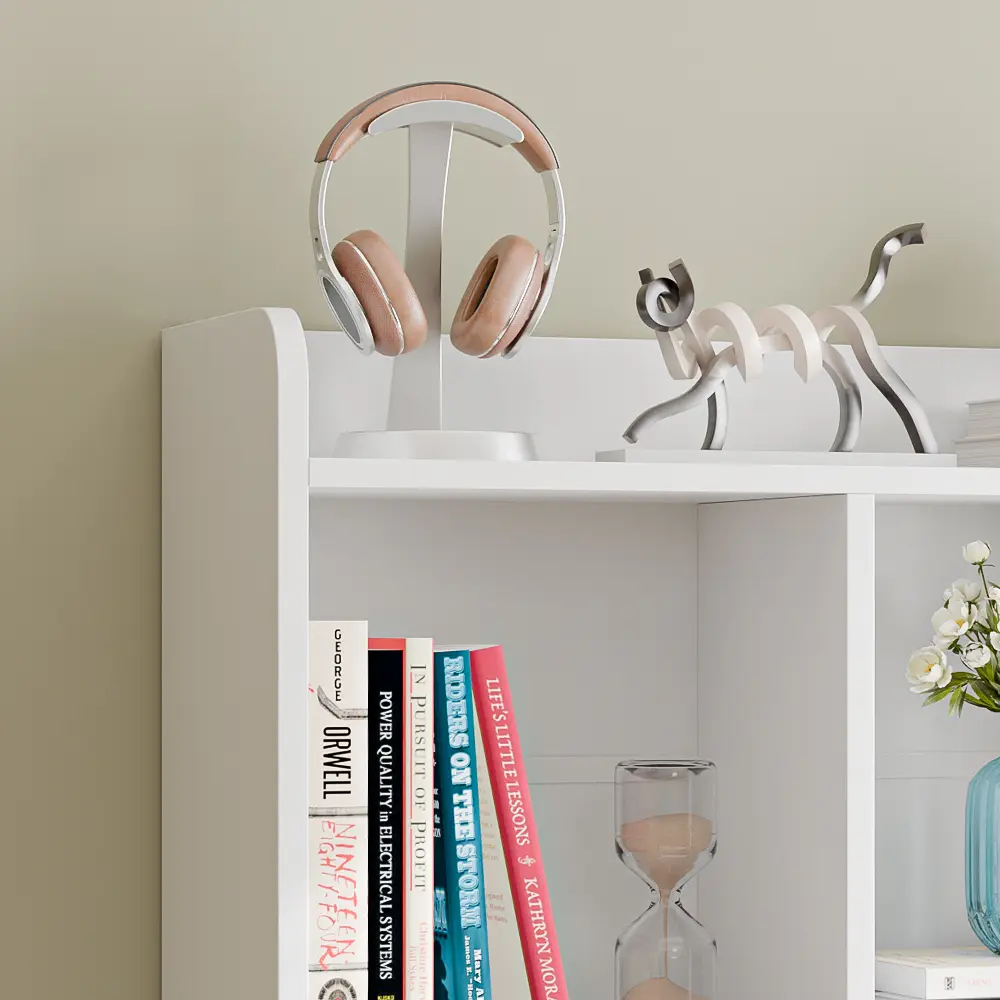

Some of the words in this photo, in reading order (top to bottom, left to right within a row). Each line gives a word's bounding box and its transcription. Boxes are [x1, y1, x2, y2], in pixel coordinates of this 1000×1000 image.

[334, 629, 342, 702] GEORGE
[379, 691, 393, 741] POWER
[443, 655, 470, 749] RIDERS
[486, 676, 509, 722] LIFE'S
[323, 726, 352, 800] ORWELL
[410, 696, 427, 780] PURSUIT
[450, 751, 472, 786] ON
[495, 723, 518, 779] LITTLE
[376, 744, 393, 810] QUALITY
[414, 787, 426, 812] OF
[379, 811, 393, 823] in
[452, 789, 476, 842] THE
[505, 780, 531, 846] LESSONS
[379, 826, 393, 914] ELECTRICAL
[410, 821, 427, 892] PROFIT
[456, 843, 482, 930] STORM
[317, 820, 340, 971] EIGHTY-FOUR
[335, 823, 358, 957] NINETEEN
[523, 877, 551, 954] KATHRYN
[379, 917, 393, 980] SYSTEMS
[473, 949, 482, 984] Mary
